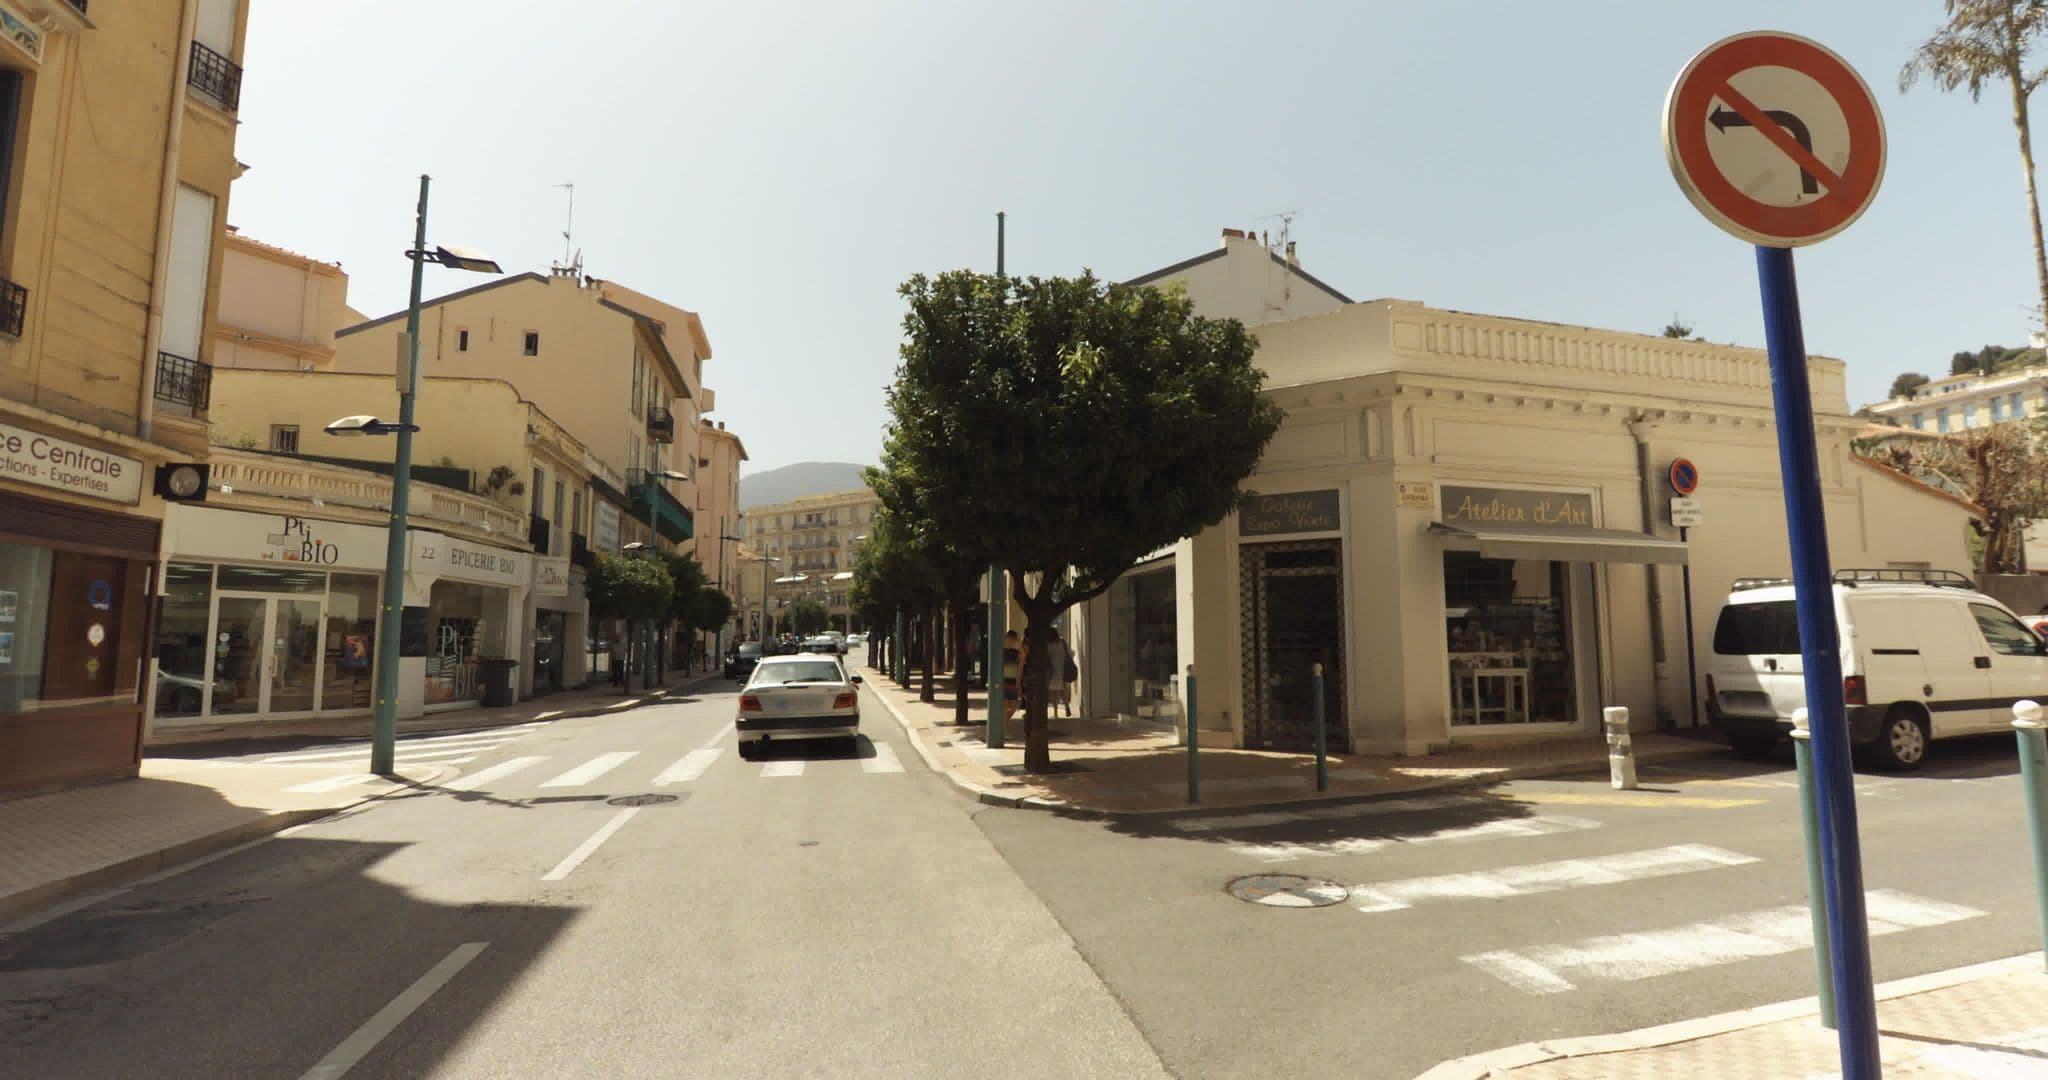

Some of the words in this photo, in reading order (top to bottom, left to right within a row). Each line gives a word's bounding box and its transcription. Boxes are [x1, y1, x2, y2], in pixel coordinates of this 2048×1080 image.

[31, 438, 122, 478] Centrale
[50, 467, 109, 492] Expertises
[1448, 495, 1524, 521] Atelier
[301, 539, 338, 565] BIO
[421, 546, 436, 560] 22
[451, 548, 497, 572] EPICERIE
[499, 557, 516, 574] BIO
